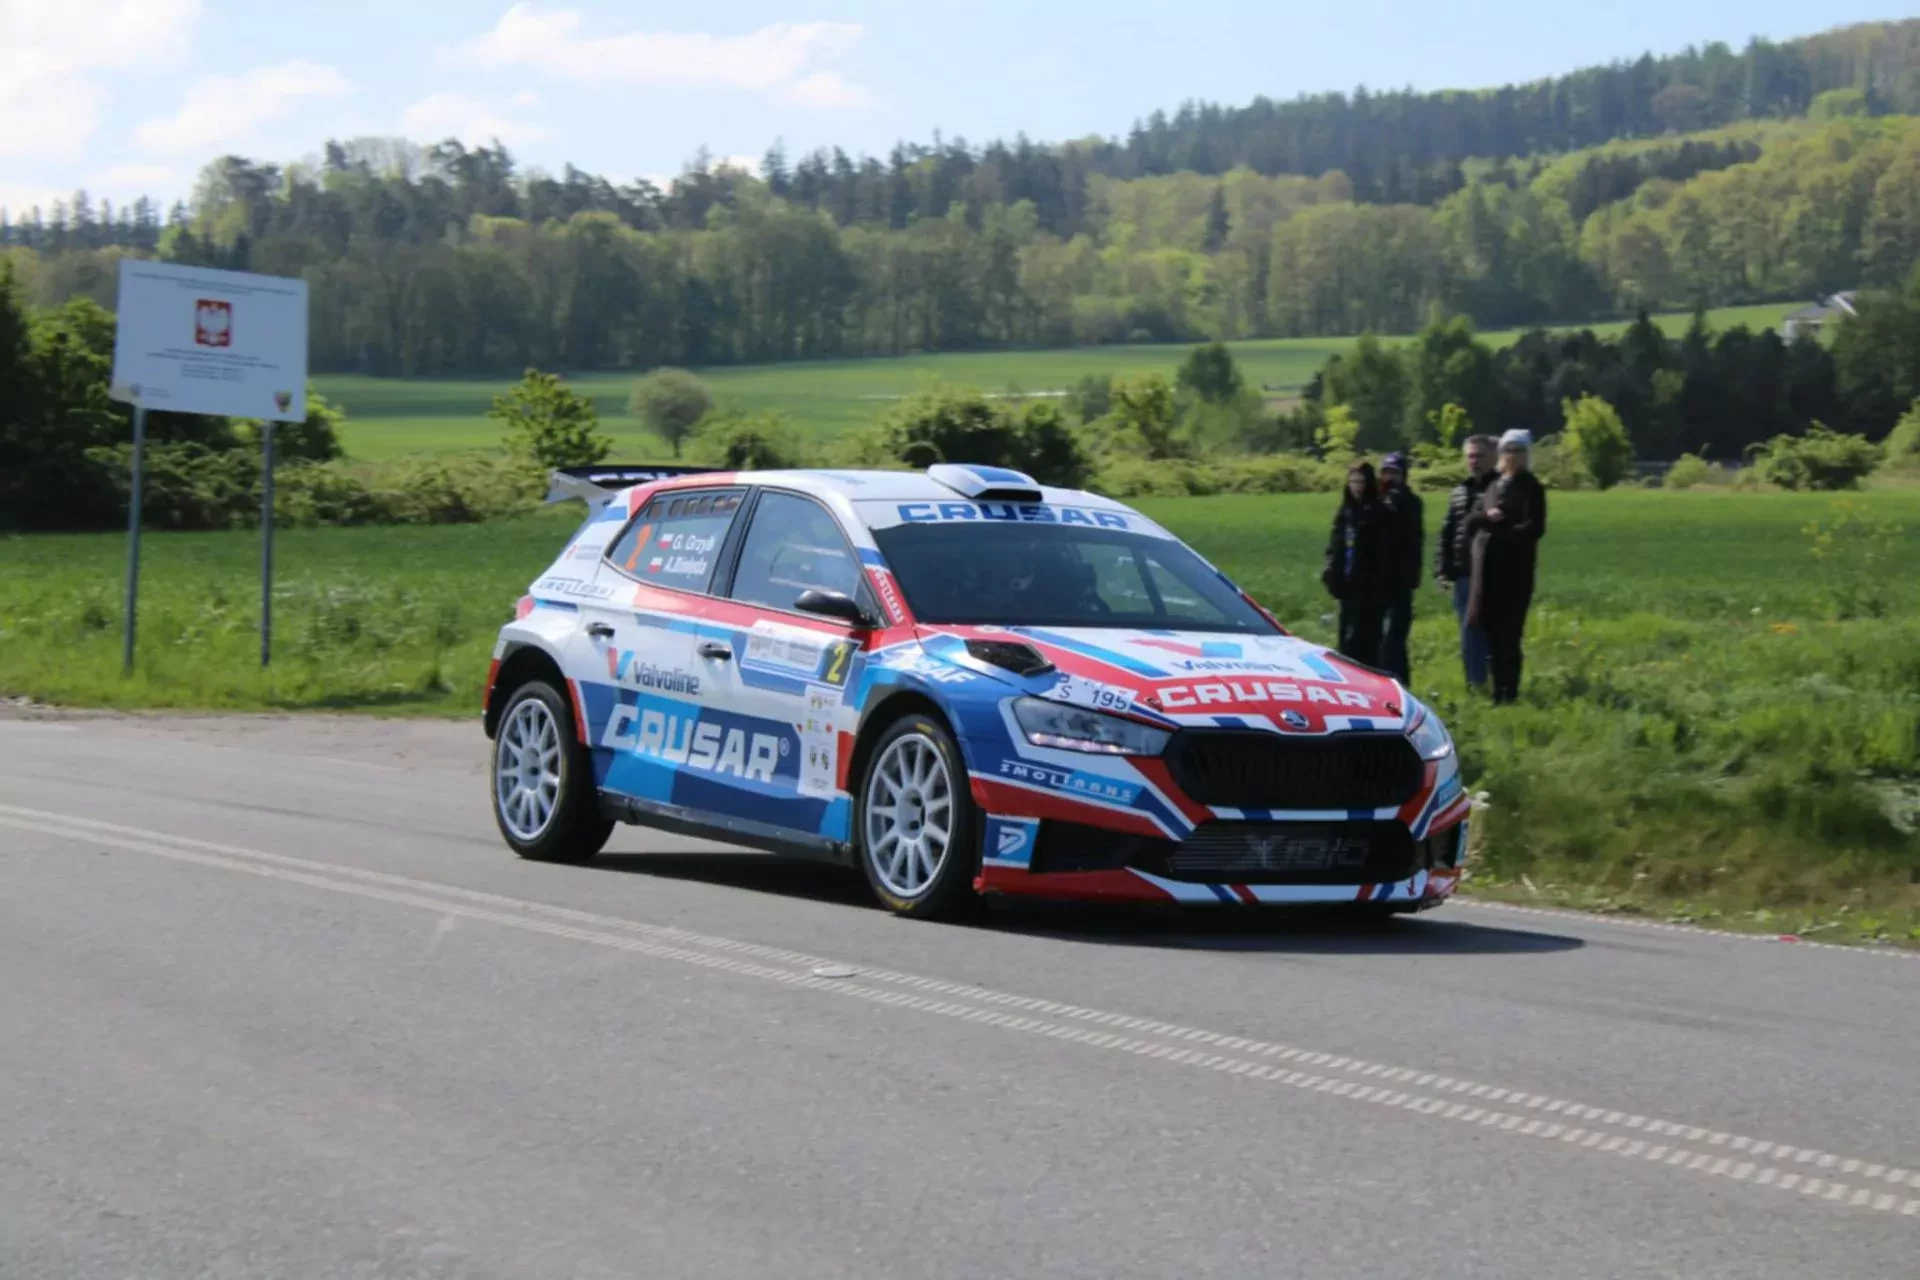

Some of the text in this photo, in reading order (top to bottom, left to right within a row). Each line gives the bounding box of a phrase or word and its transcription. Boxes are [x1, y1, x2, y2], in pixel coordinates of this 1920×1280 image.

[897, 503, 1129, 529] CRUSAR
[827, 643, 849, 683] 2
[634, 660, 700, 695] Valvoline
[1092, 689, 1127, 711] 195
[1156, 682, 1371, 709] CRUSAR
